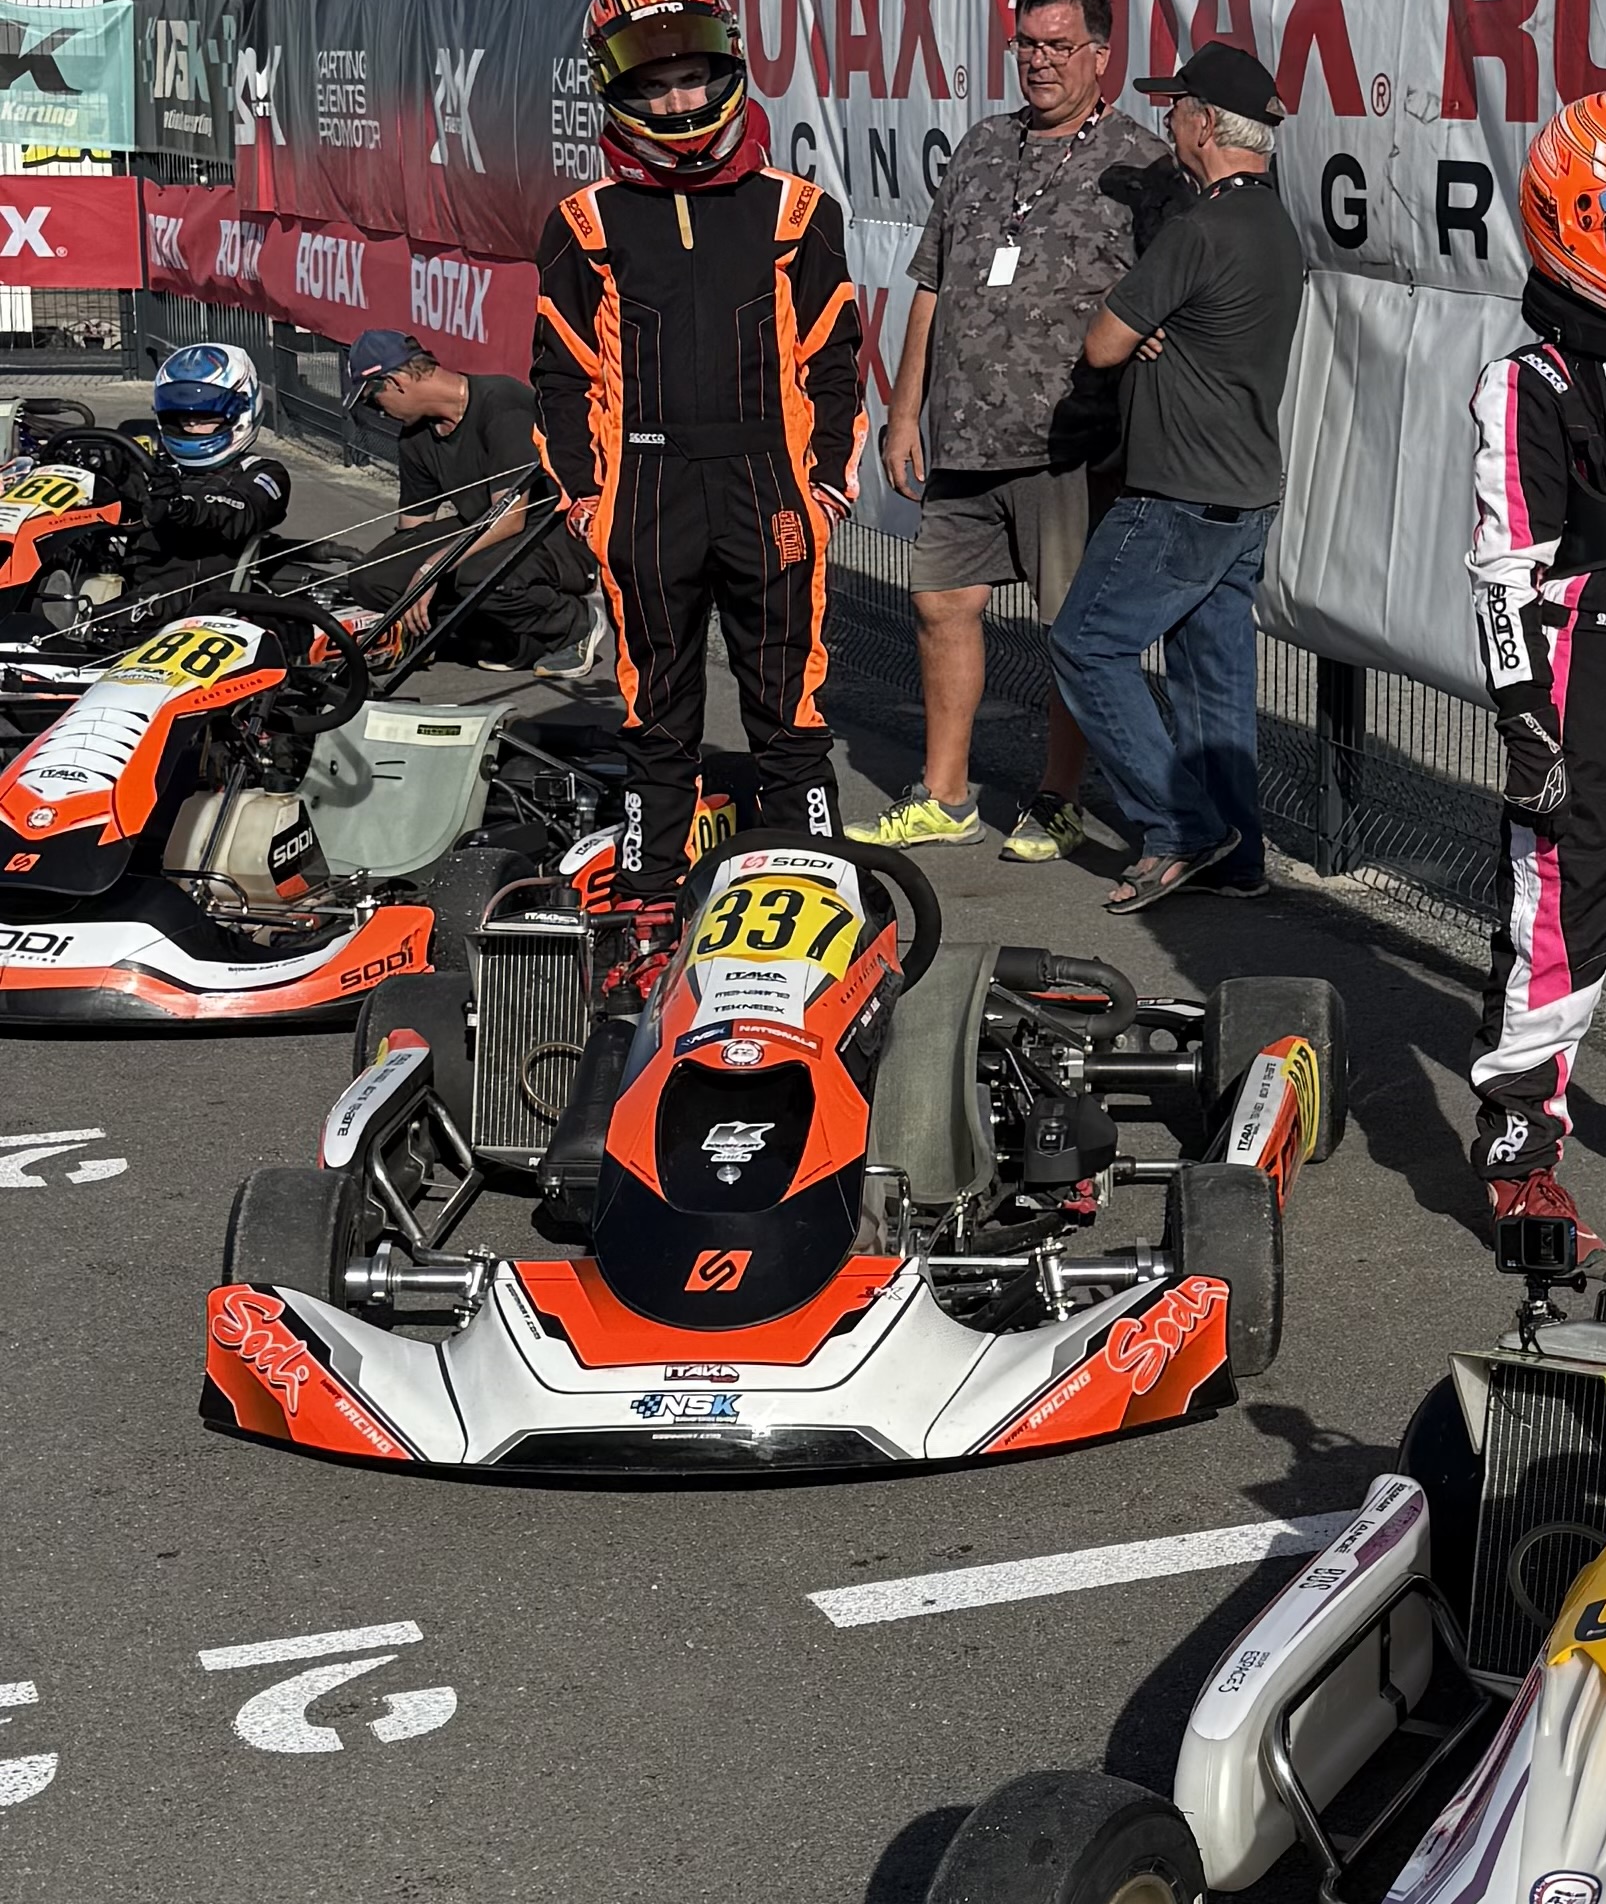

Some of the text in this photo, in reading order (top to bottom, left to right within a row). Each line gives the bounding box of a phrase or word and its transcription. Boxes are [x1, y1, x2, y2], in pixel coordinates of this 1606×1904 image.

[318, 84, 366, 115] EVENTS
[790, 120, 949, 203] CING
[789, 184, 816, 227] sparco
[296, 232, 369, 309] ROTAX
[411, 255, 493, 344] ROTAX
[1487, 582, 1521, 671] sparco
[806, 786, 833, 838] rco
[771, 856, 834, 870] SODI
[697, 888, 855, 961] 337
[665, 1366, 740, 1379] ITAKA
[1029, 1368, 1093, 1429] RACING
[334, 1393, 395, 1455] RACING
[656, 1393, 742, 1417] NSK
